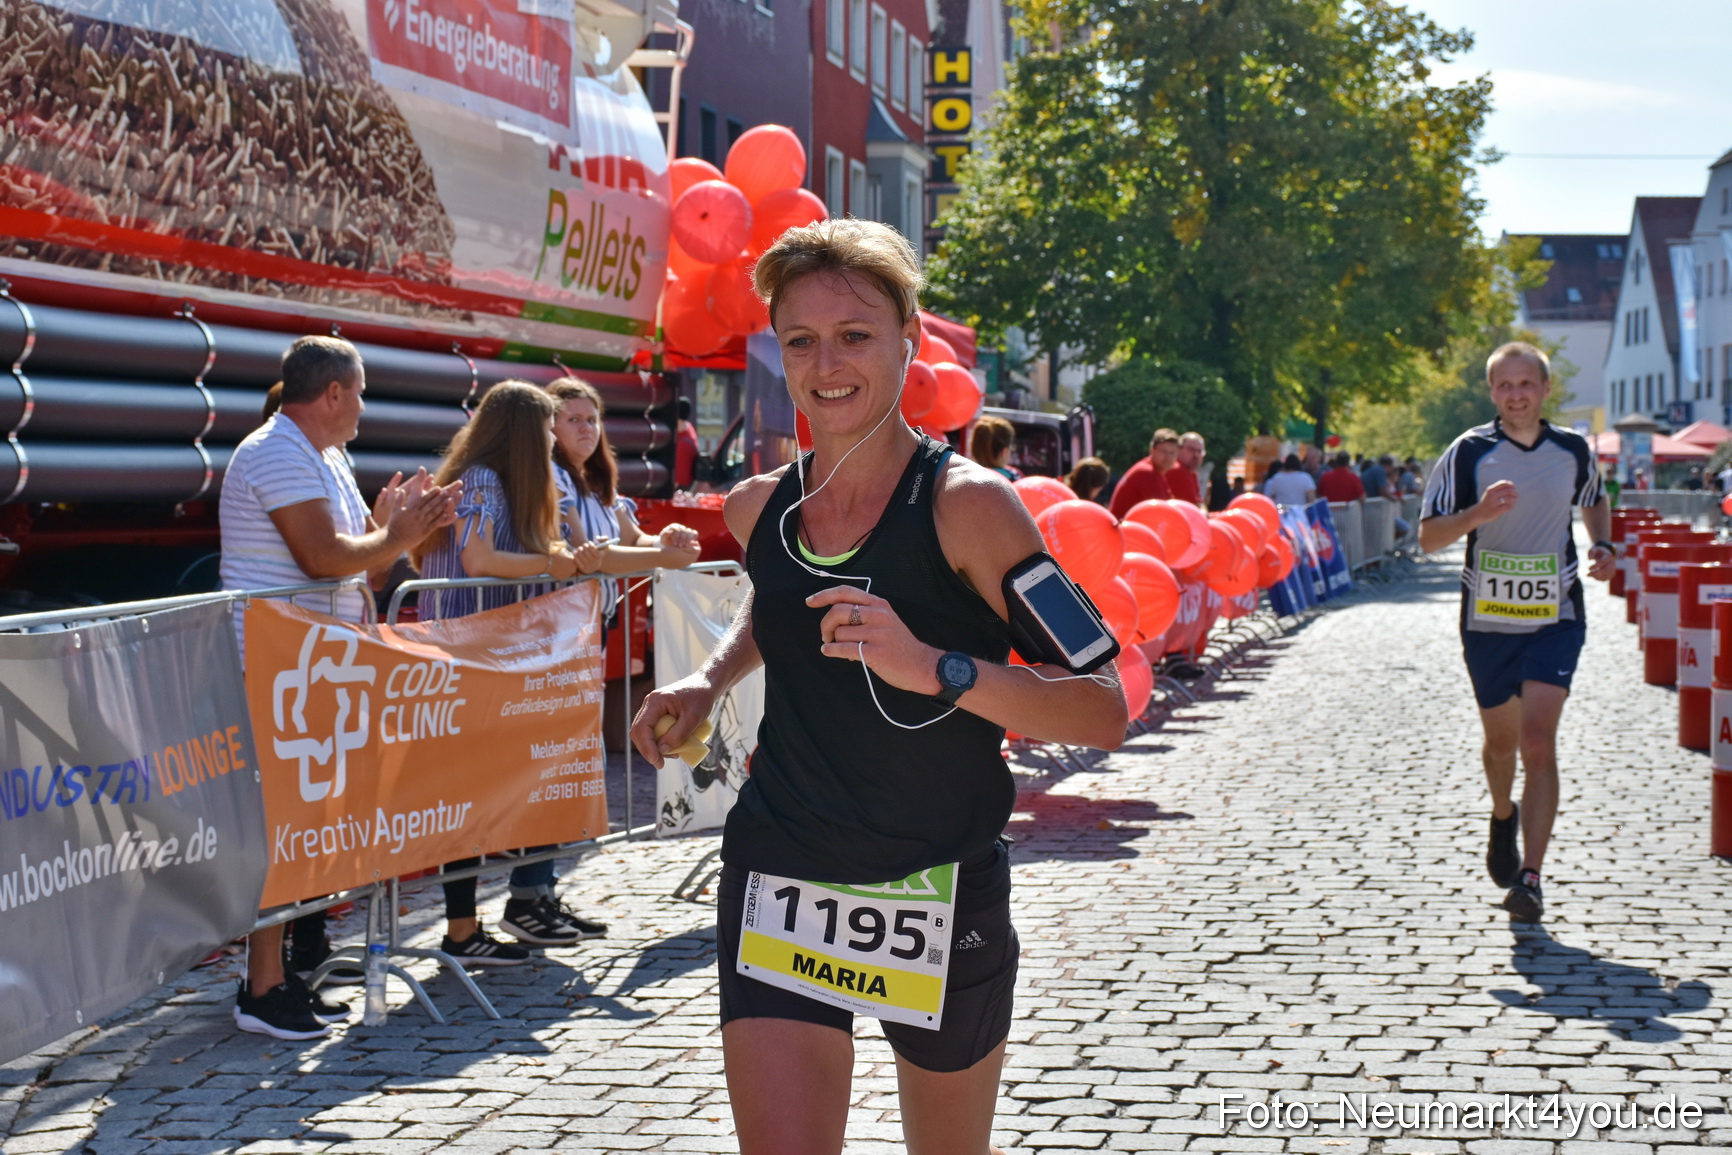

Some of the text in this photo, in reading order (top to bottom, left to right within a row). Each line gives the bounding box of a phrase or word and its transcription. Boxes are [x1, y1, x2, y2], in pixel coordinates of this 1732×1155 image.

[405, 0, 560, 110] Energieberatung
[534, 188, 646, 301] Pellets
[907, 472, 924, 505] Reebok
[1484, 553, 1553, 573] BOCK
[1487, 577, 1550, 600] 1105
[1483, 603, 1550, 616] JOHANNES
[385, 660, 461, 699] CODE
[524, 674, 545, 692] Ihrer
[546, 667, 578, 691] Projekte
[500, 694, 564, 717] Grafikdesign
[564, 688, 581, 708] und
[380, 699, 466, 744] CLINIC
[153, 725, 246, 797] LOUNGE
[530, 740, 565, 760] Melden
[577, 733, 598, 750] sich
[544, 782, 578, 801] 09181
[274, 800, 472, 864] KreativAgentur
[774, 885, 928, 960] 1195
[792, 953, 887, 998] MARIA
